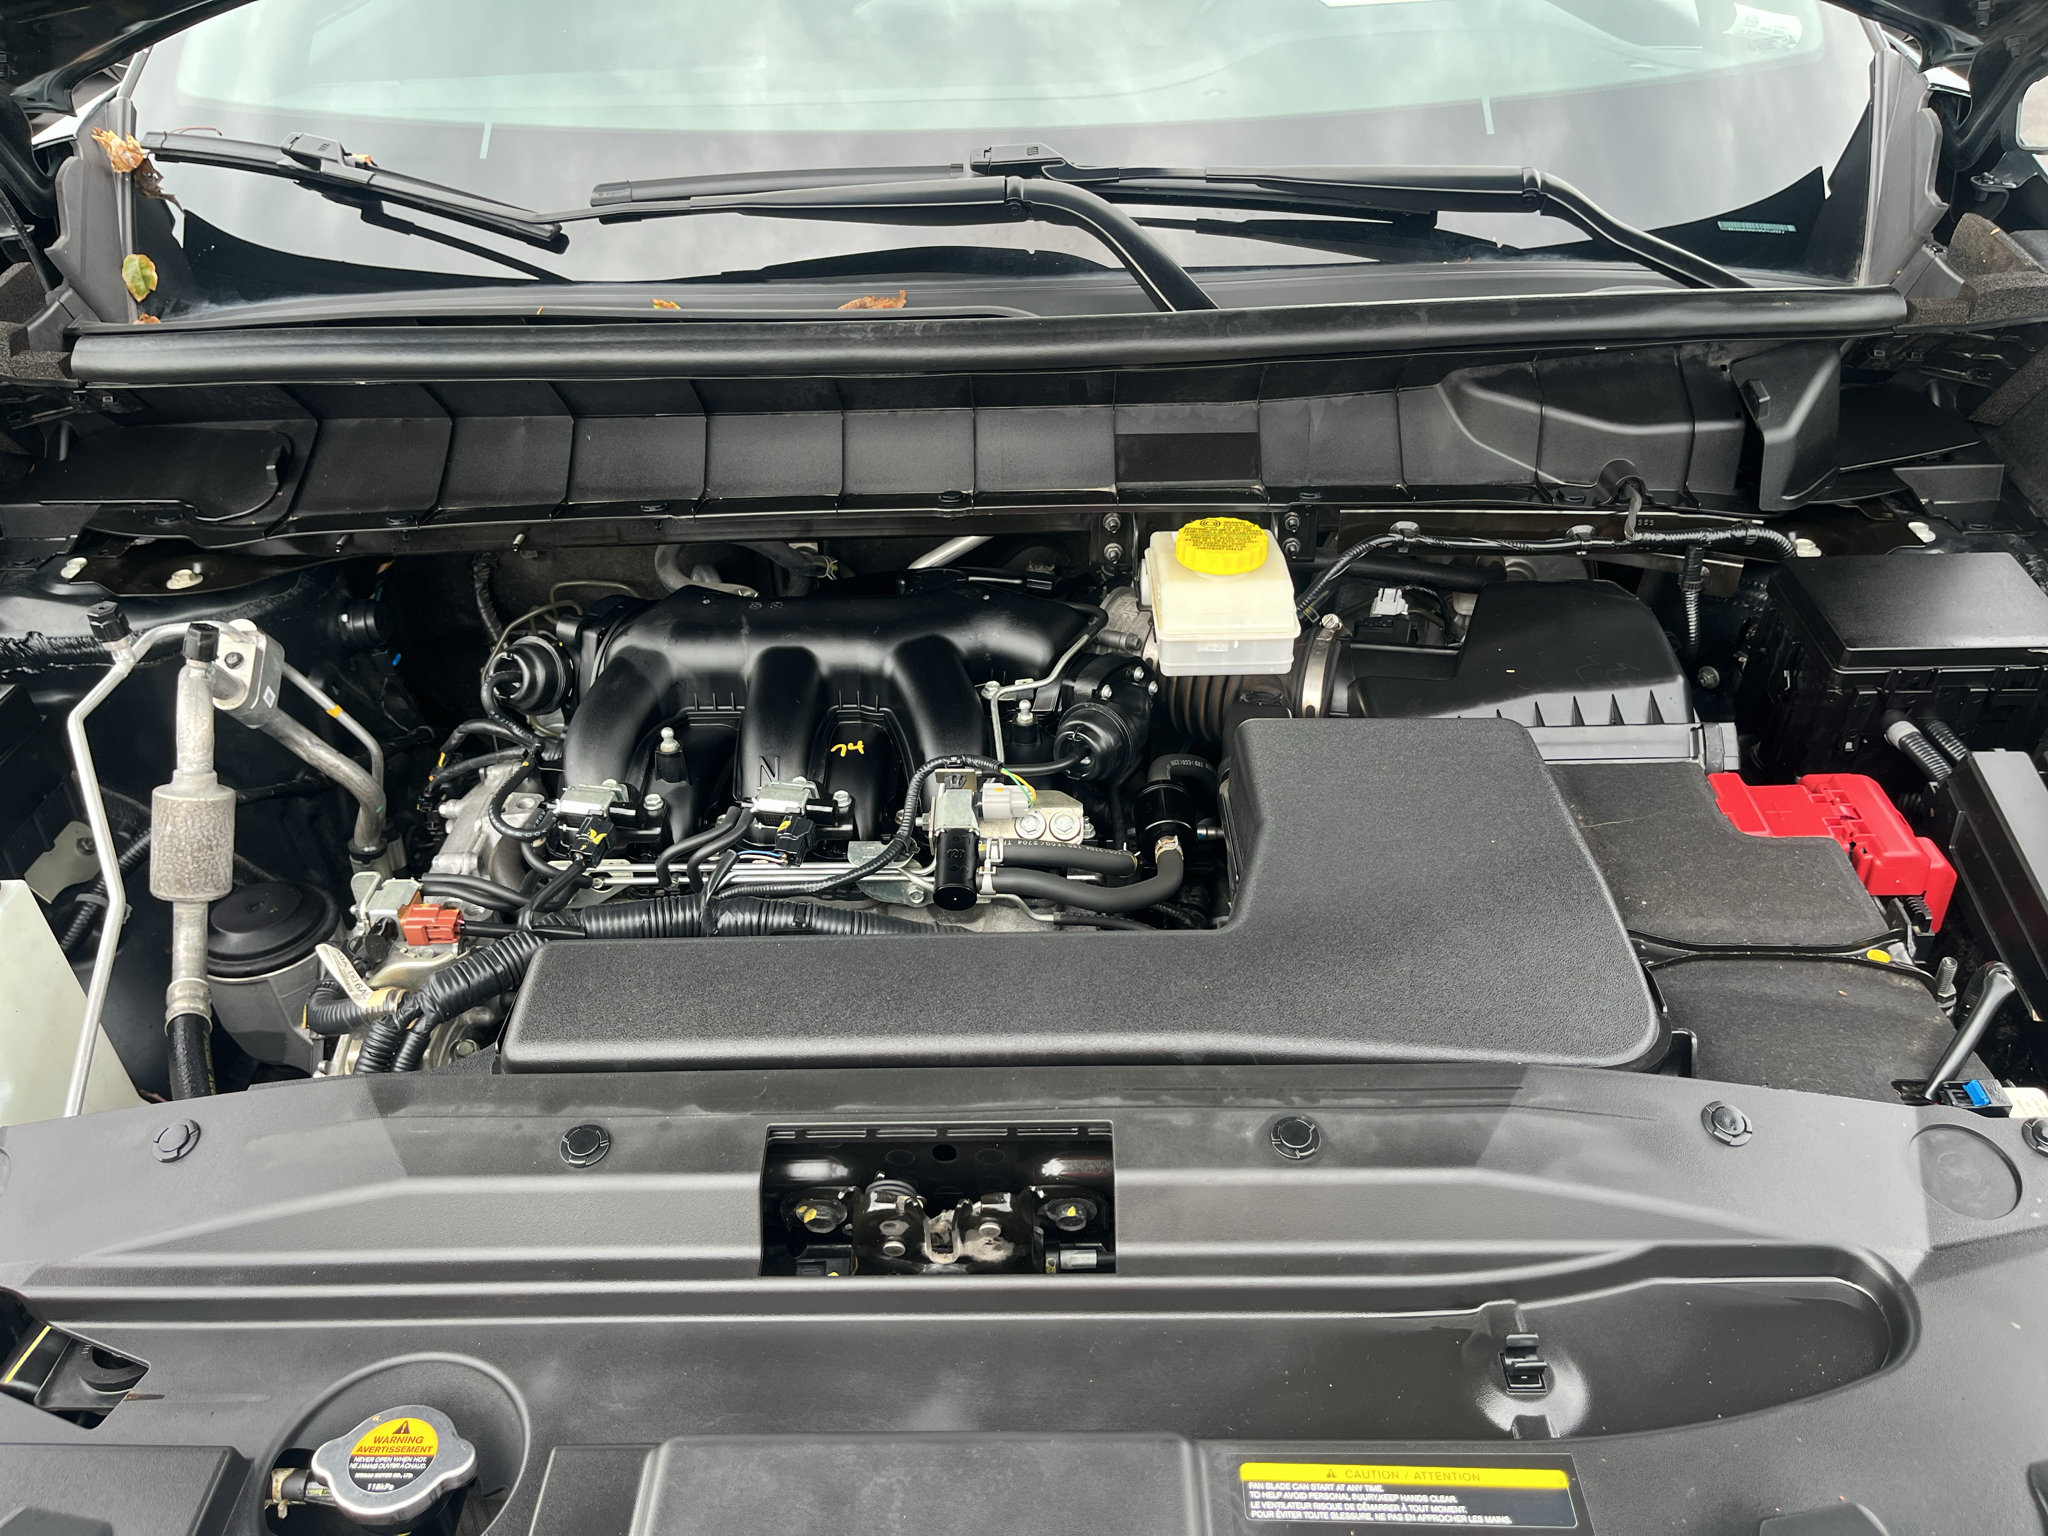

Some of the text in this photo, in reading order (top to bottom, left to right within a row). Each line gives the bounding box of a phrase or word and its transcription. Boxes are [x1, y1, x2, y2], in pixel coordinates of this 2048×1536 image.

[759, 756, 780, 786] N
[1345, 1469, 1400, 1480] CAUTION
[1414, 1471, 1481, 1482] ATTENTION
[1283, 1492, 1307, 1500] AVOID
[1308, 1492, 1351, 1501] PERSONAL
[1401, 1494, 1428, 1502] HANDS
[1430, 1495, 1458, 1503] CLEAR.
[1262, 1502, 1312, 1510] VENTILATEUR
[1313, 1502, 1342, 1510] RISQUE
[1357, 1502, 1400, 1512] DÉMARRER
[1401, 1503, 1408, 1512] À
[1408, 1505, 1429, 1513] TOUT
[1431, 1505, 1468, 1514] MOMENT.
[1276, 1509, 1302, 1519] ÉVITER
[1330, 1512, 1374, 1521] BLESSURE,
[1418, 1515, 1467, 1523] APPROCHER
[1485, 1516, 1512, 1524] MAINS.
